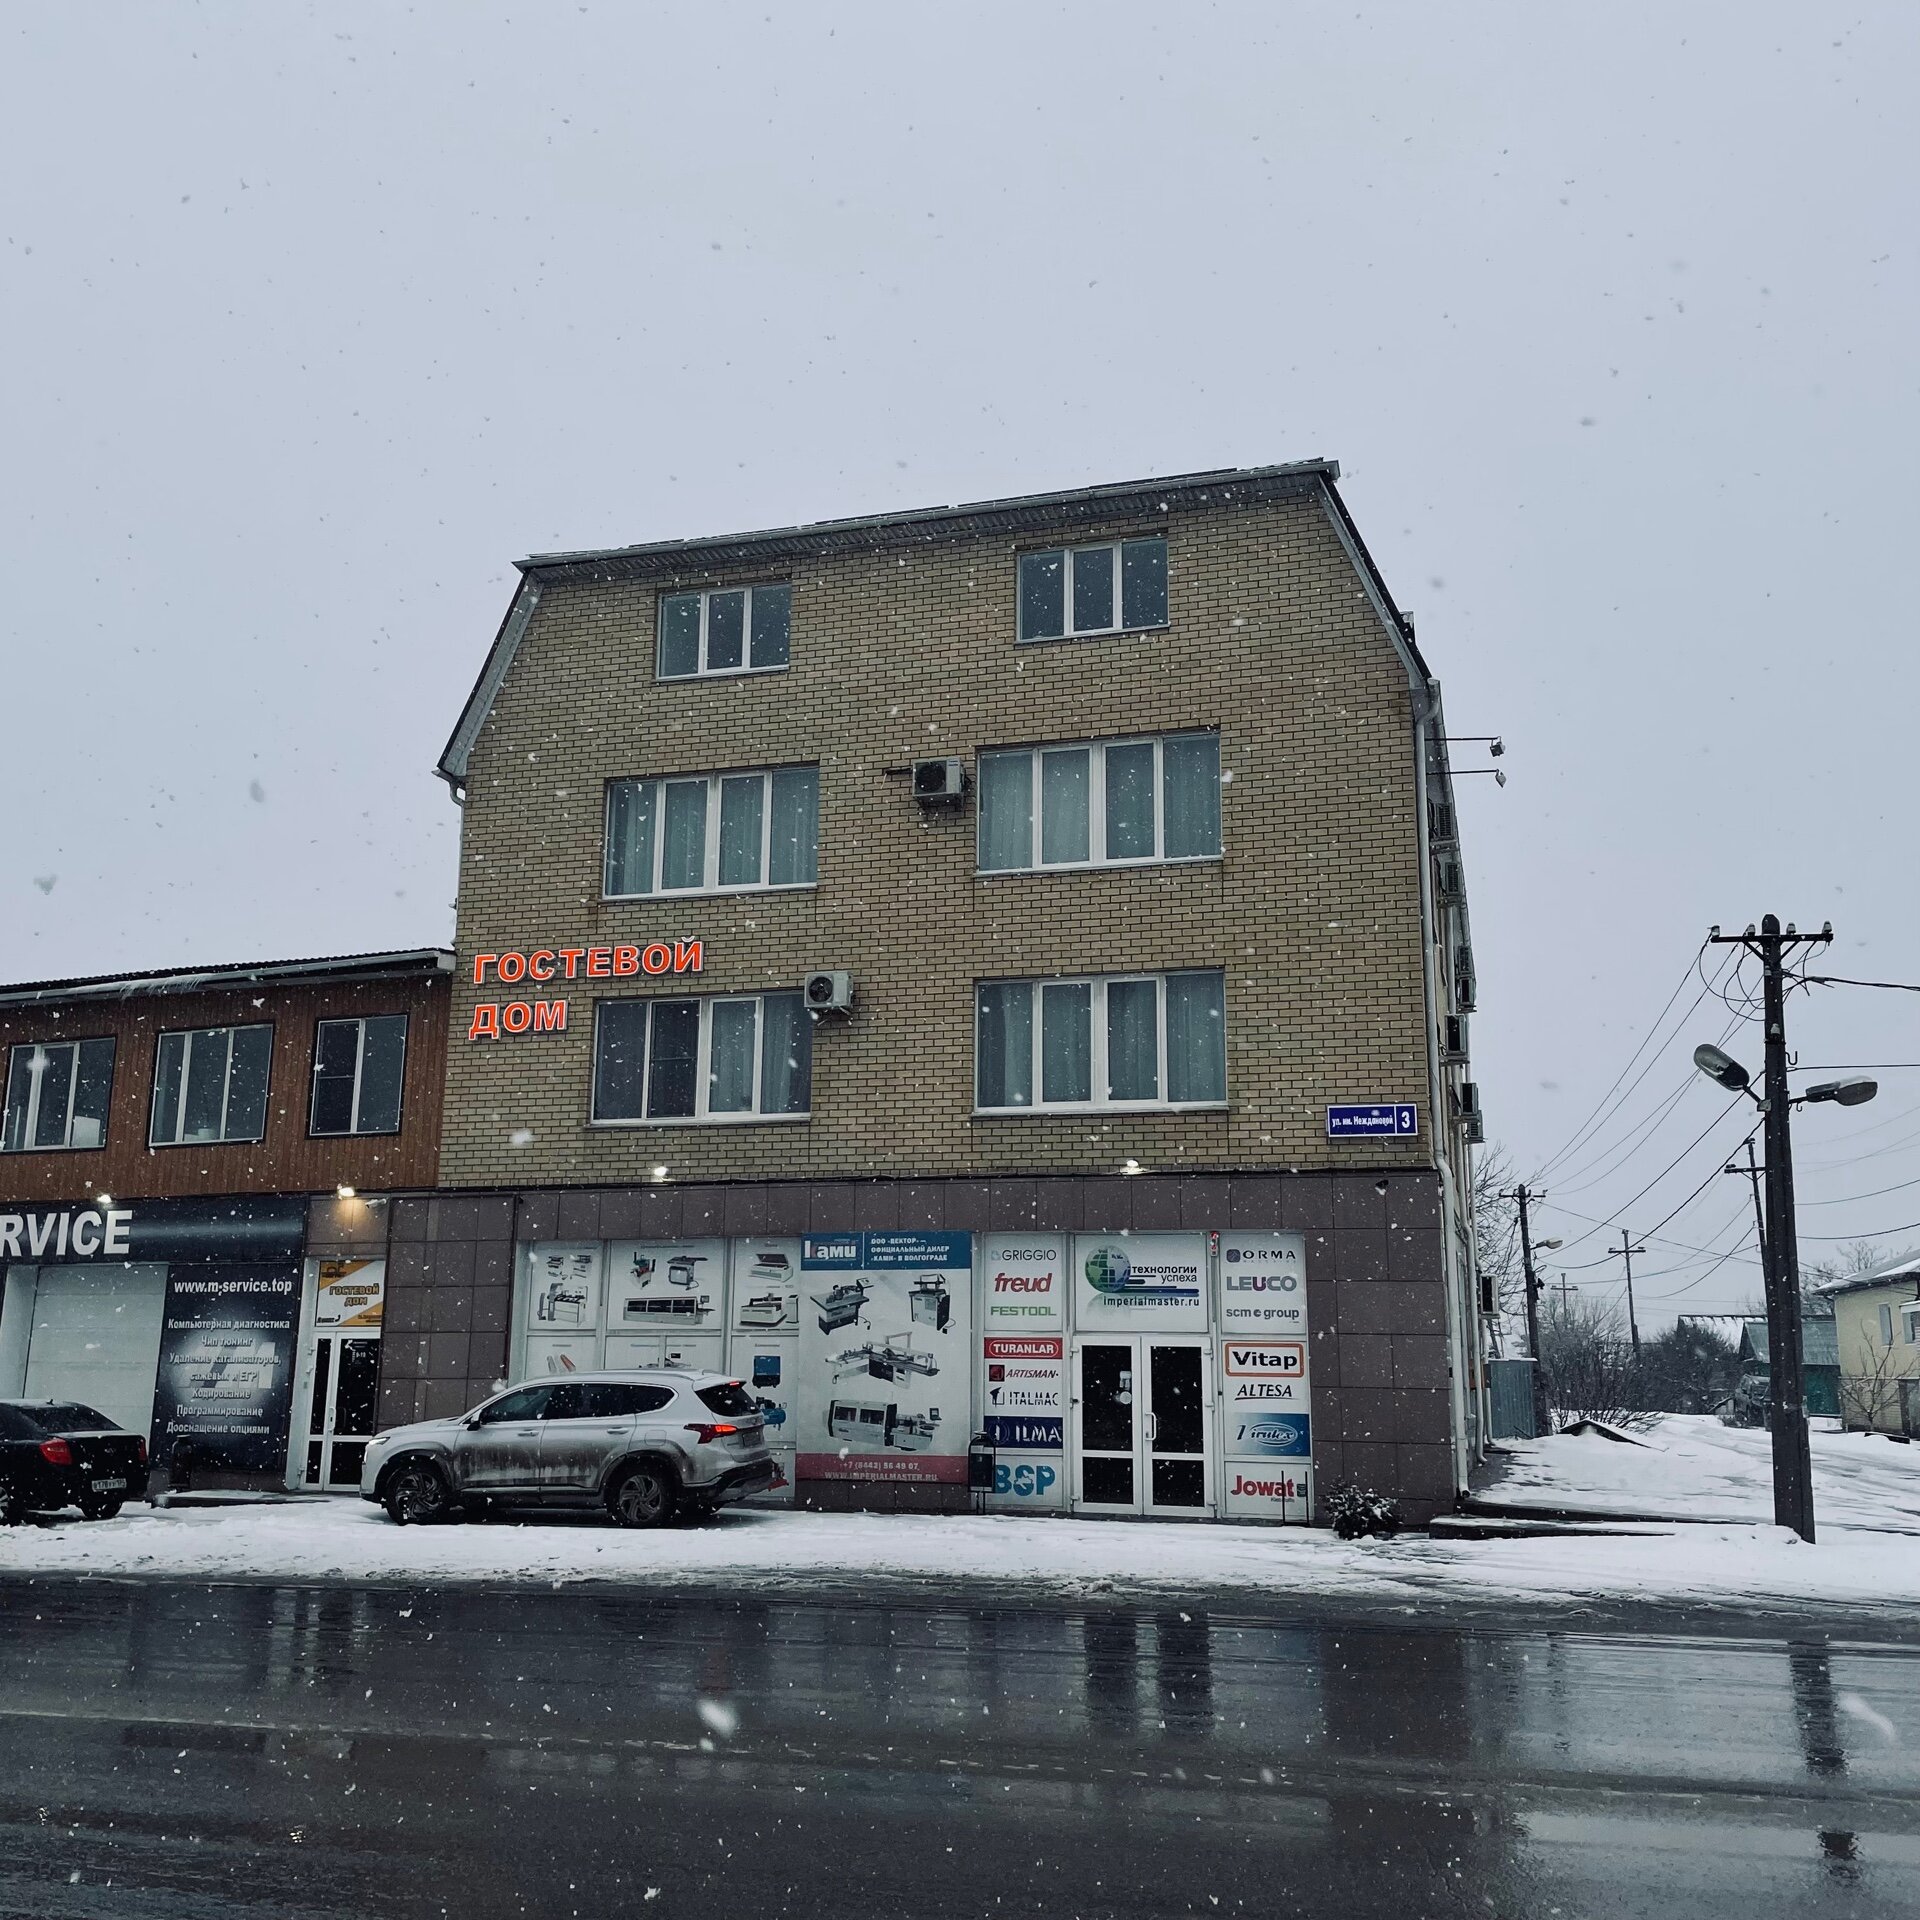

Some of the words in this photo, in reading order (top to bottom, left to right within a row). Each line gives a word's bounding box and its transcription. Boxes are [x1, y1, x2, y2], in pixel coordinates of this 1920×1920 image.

[473, 936, 703, 984] ГОСТЕВОЙ
[468, 1000, 569, 1040] ДОМ
[1401, 1111, 1410, 1128] 3
[0, 1210, 133, 1257] RVICE
[871, 1245, 925, 1253] ОФИЦИАЛЬНЫЙ
[926, 1245, 950, 1253] ДИЛЕР
[1002, 1249, 1057, 1261] GRIGGIO
[1243, 1250, 1296, 1260] ORMA
[1132, 1265, 1197, 1274] технологии
[995, 1272, 1053, 1292] freud
[1161, 1274, 1197, 1284] успеха
[1226, 1275, 1297, 1292] LEUCO
[174, 1278, 292, 1295] www.m-service.top
[329, 1283, 380, 1295] ГОСТЕВОЙ
[344, 1297, 368, 1307] ДОМ
[1103, 1295, 1200, 1308] imperialmaster.ru
[991, 1306, 1057, 1316] FESTOOL
[1226, 1308, 1251, 1318] scm
[1263, 1309, 1300, 1321] group
[168, 1318, 232, 1332] Компьютерная
[233, 1320, 290, 1331] диагностика
[202, 1335, 218, 1347] Чип
[220, 1338, 253, 1347] тюнинг
[993, 1343, 1054, 1354] TURANLAR
[169, 1352, 211, 1364] Удаление
[1232, 1351, 1297, 1370] Vitap
[240, 1372, 257, 1382] ЕГР
[1006, 1369, 1056, 1379] ARTISMAN
[192, 1389, 251, 1400] Кодирование
[1237, 1384, 1292, 1397] ALTESA
[1009, 1392, 1058, 1406] ITALMAC
[177, 1404, 263, 1417] Программирование
[167, 1421, 228, 1434] Дооснащение
[230, 1424, 270, 1435] опциями
[1015, 1425, 1062, 1442] ILMA
[1230, 1475, 1294, 1497] Jowat
